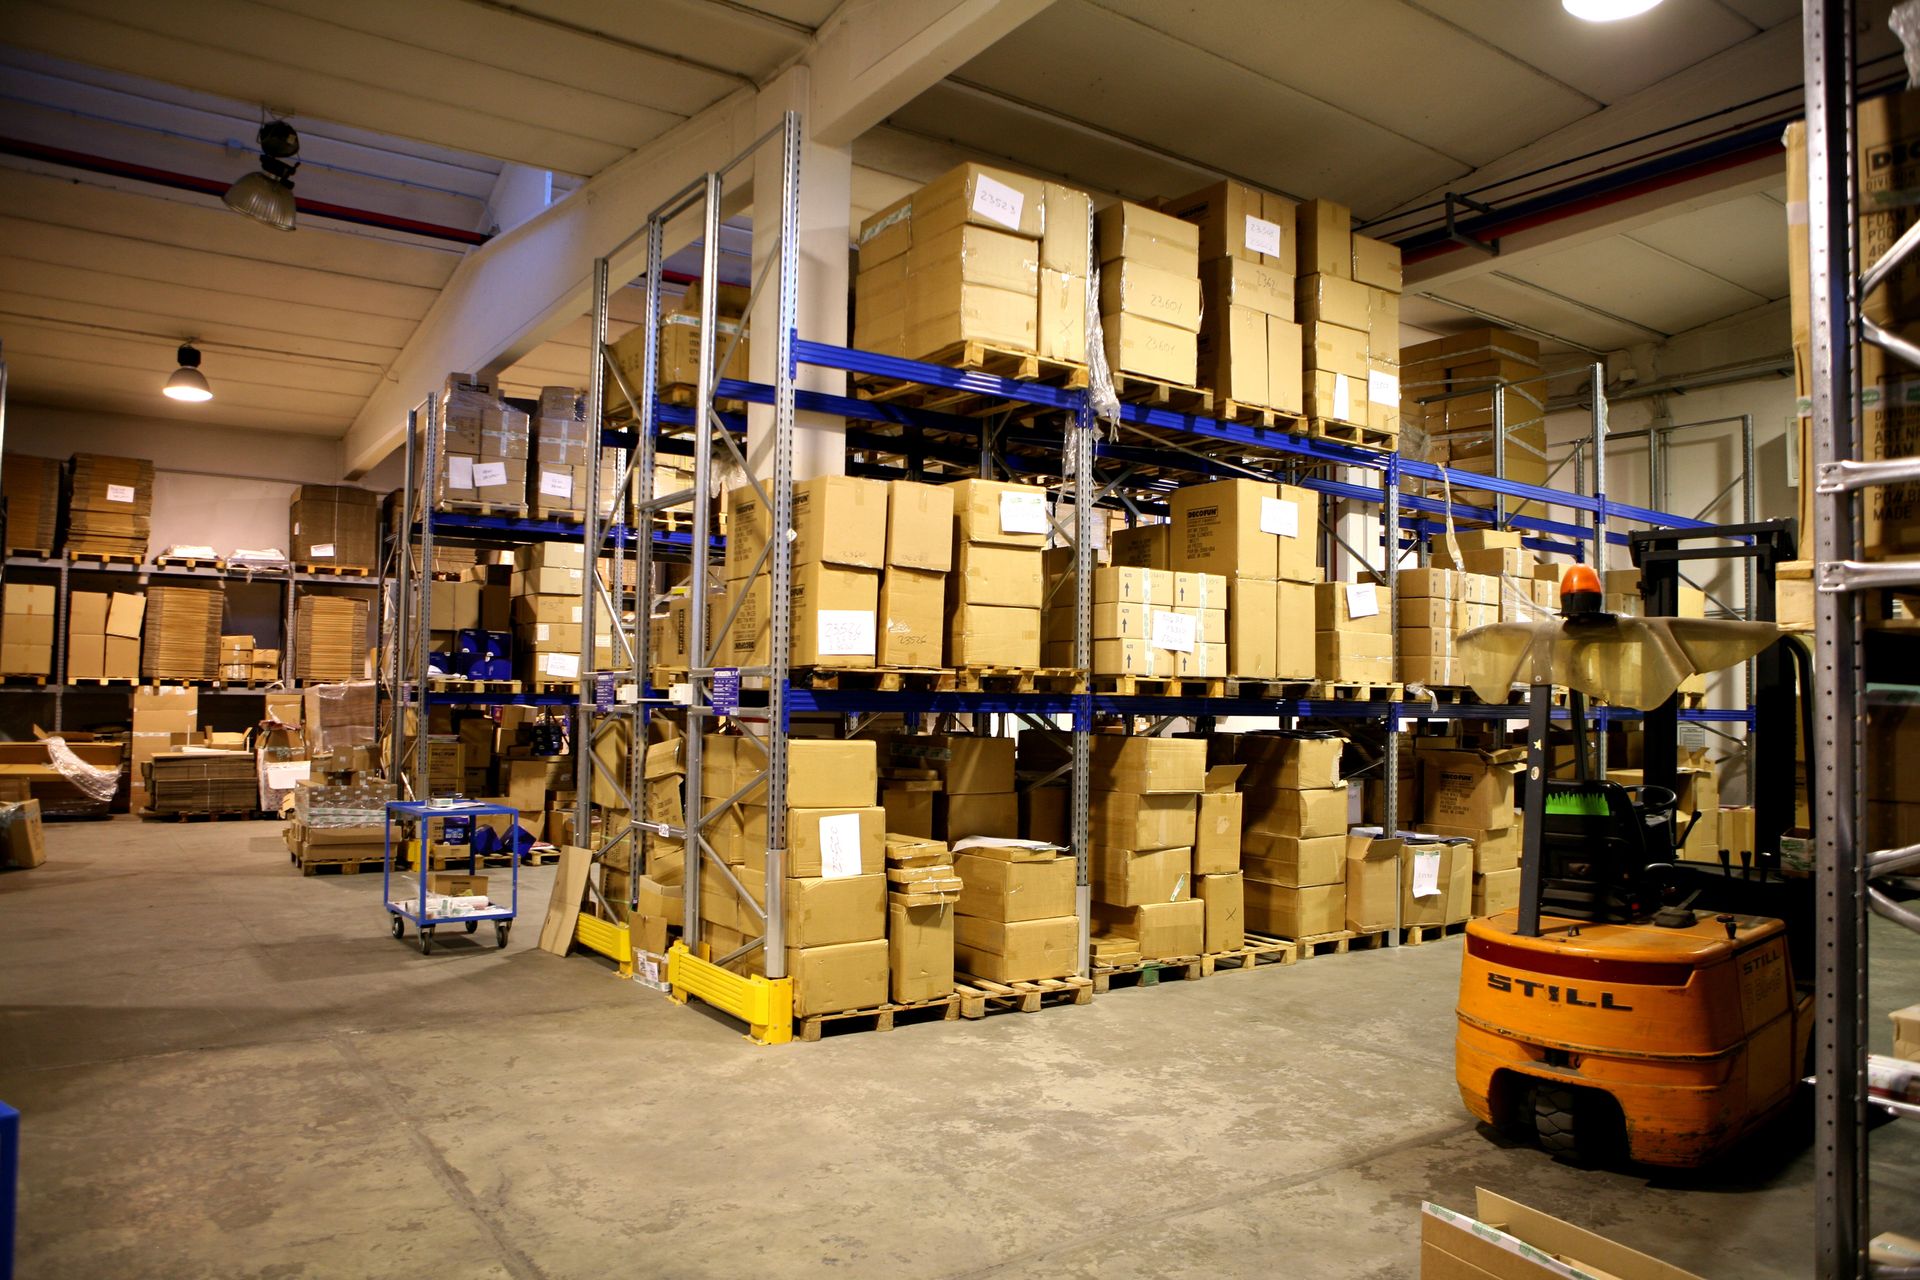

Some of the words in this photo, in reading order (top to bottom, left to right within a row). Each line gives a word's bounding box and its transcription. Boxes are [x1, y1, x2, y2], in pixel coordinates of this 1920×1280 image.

[1874, 442, 1914, 461] FOAM
[1187, 508, 1217, 518] DECOFUN
[1873, 504, 1913, 521] MADE
[1742, 948, 1782, 976] STILL
[1487, 972, 1633, 1012] STILL
